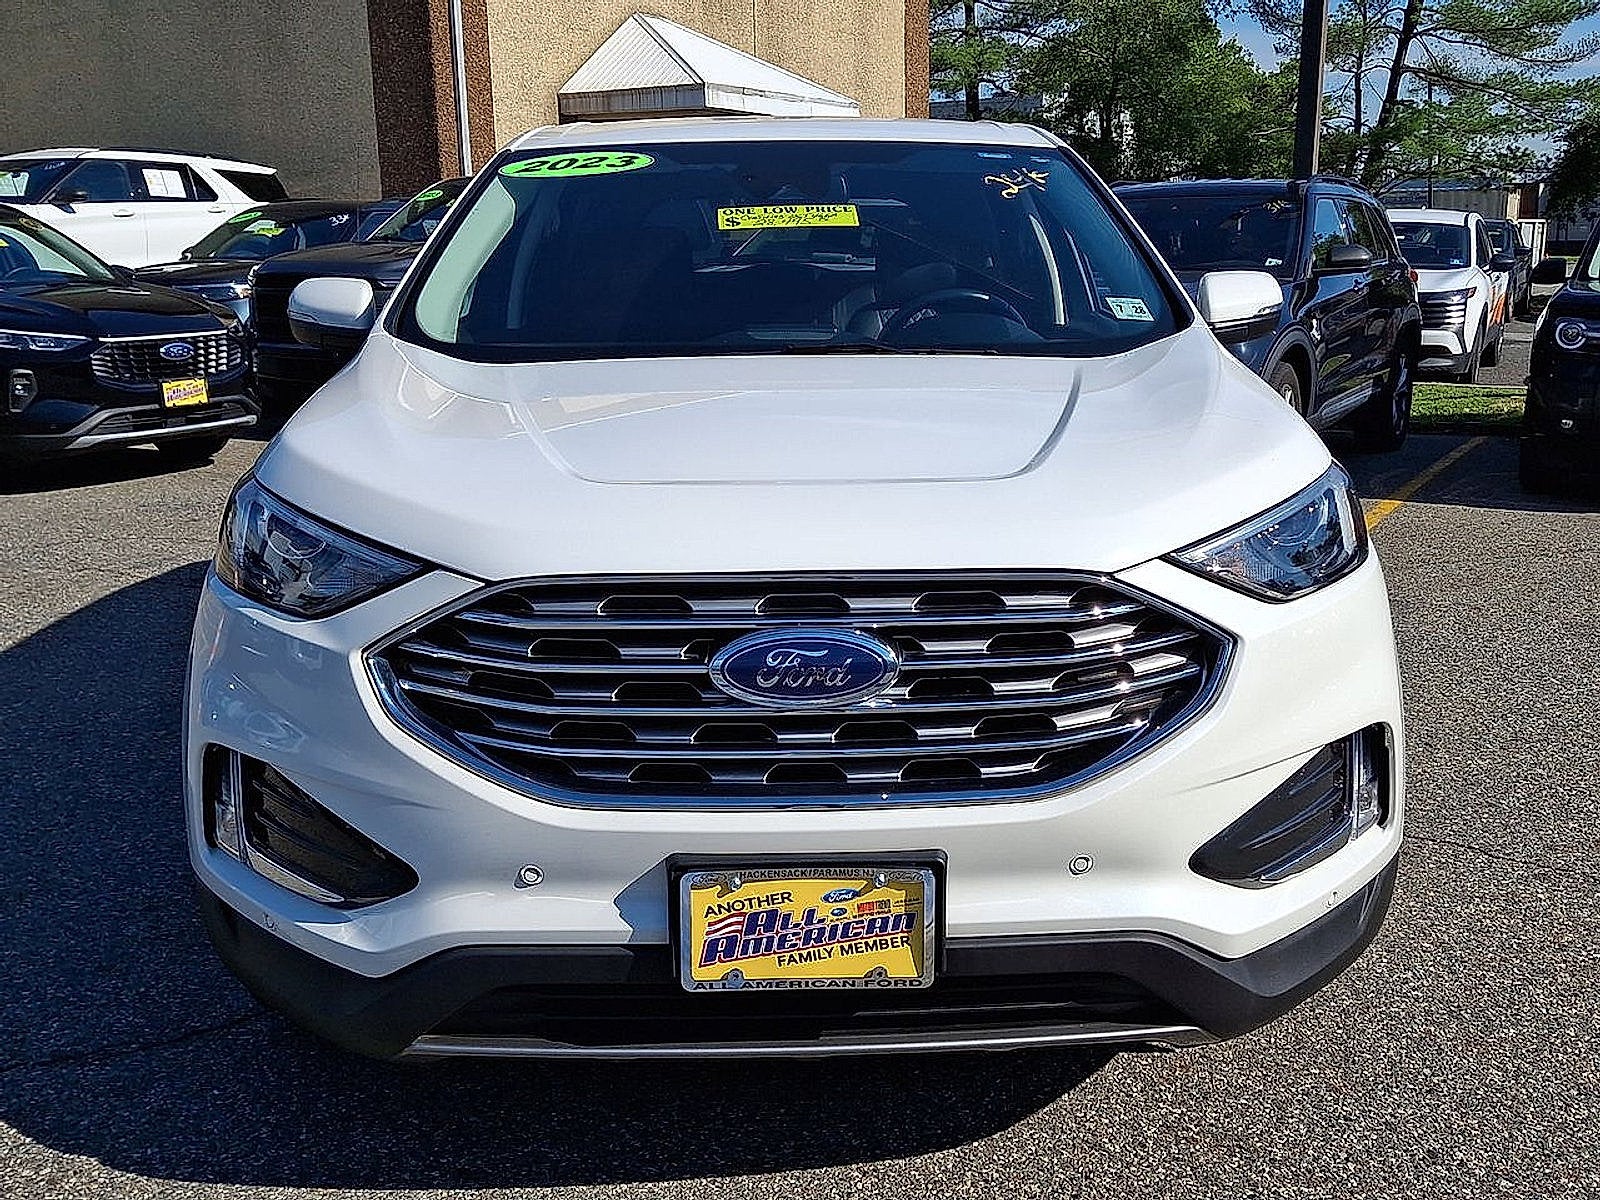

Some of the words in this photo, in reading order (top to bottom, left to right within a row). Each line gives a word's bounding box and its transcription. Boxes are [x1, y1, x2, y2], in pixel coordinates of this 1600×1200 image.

[513, 155, 640, 174] 2023
[722, 207, 756, 216] ONE
[763, 206, 798, 214] LOW
[805, 205, 853, 213] PRICE
[724, 216, 741, 228] $
[1115, 303, 1124, 313] 7
[756, 648, 853, 688] Ford
[703, 891, 793, 919] ANOTHER
[777, 947, 835, 969] FAMILY
[839, 936, 911, 957] MEMBER
[741, 980, 855, 989] AMERICAN
[864, 979, 922, 988] FORD
